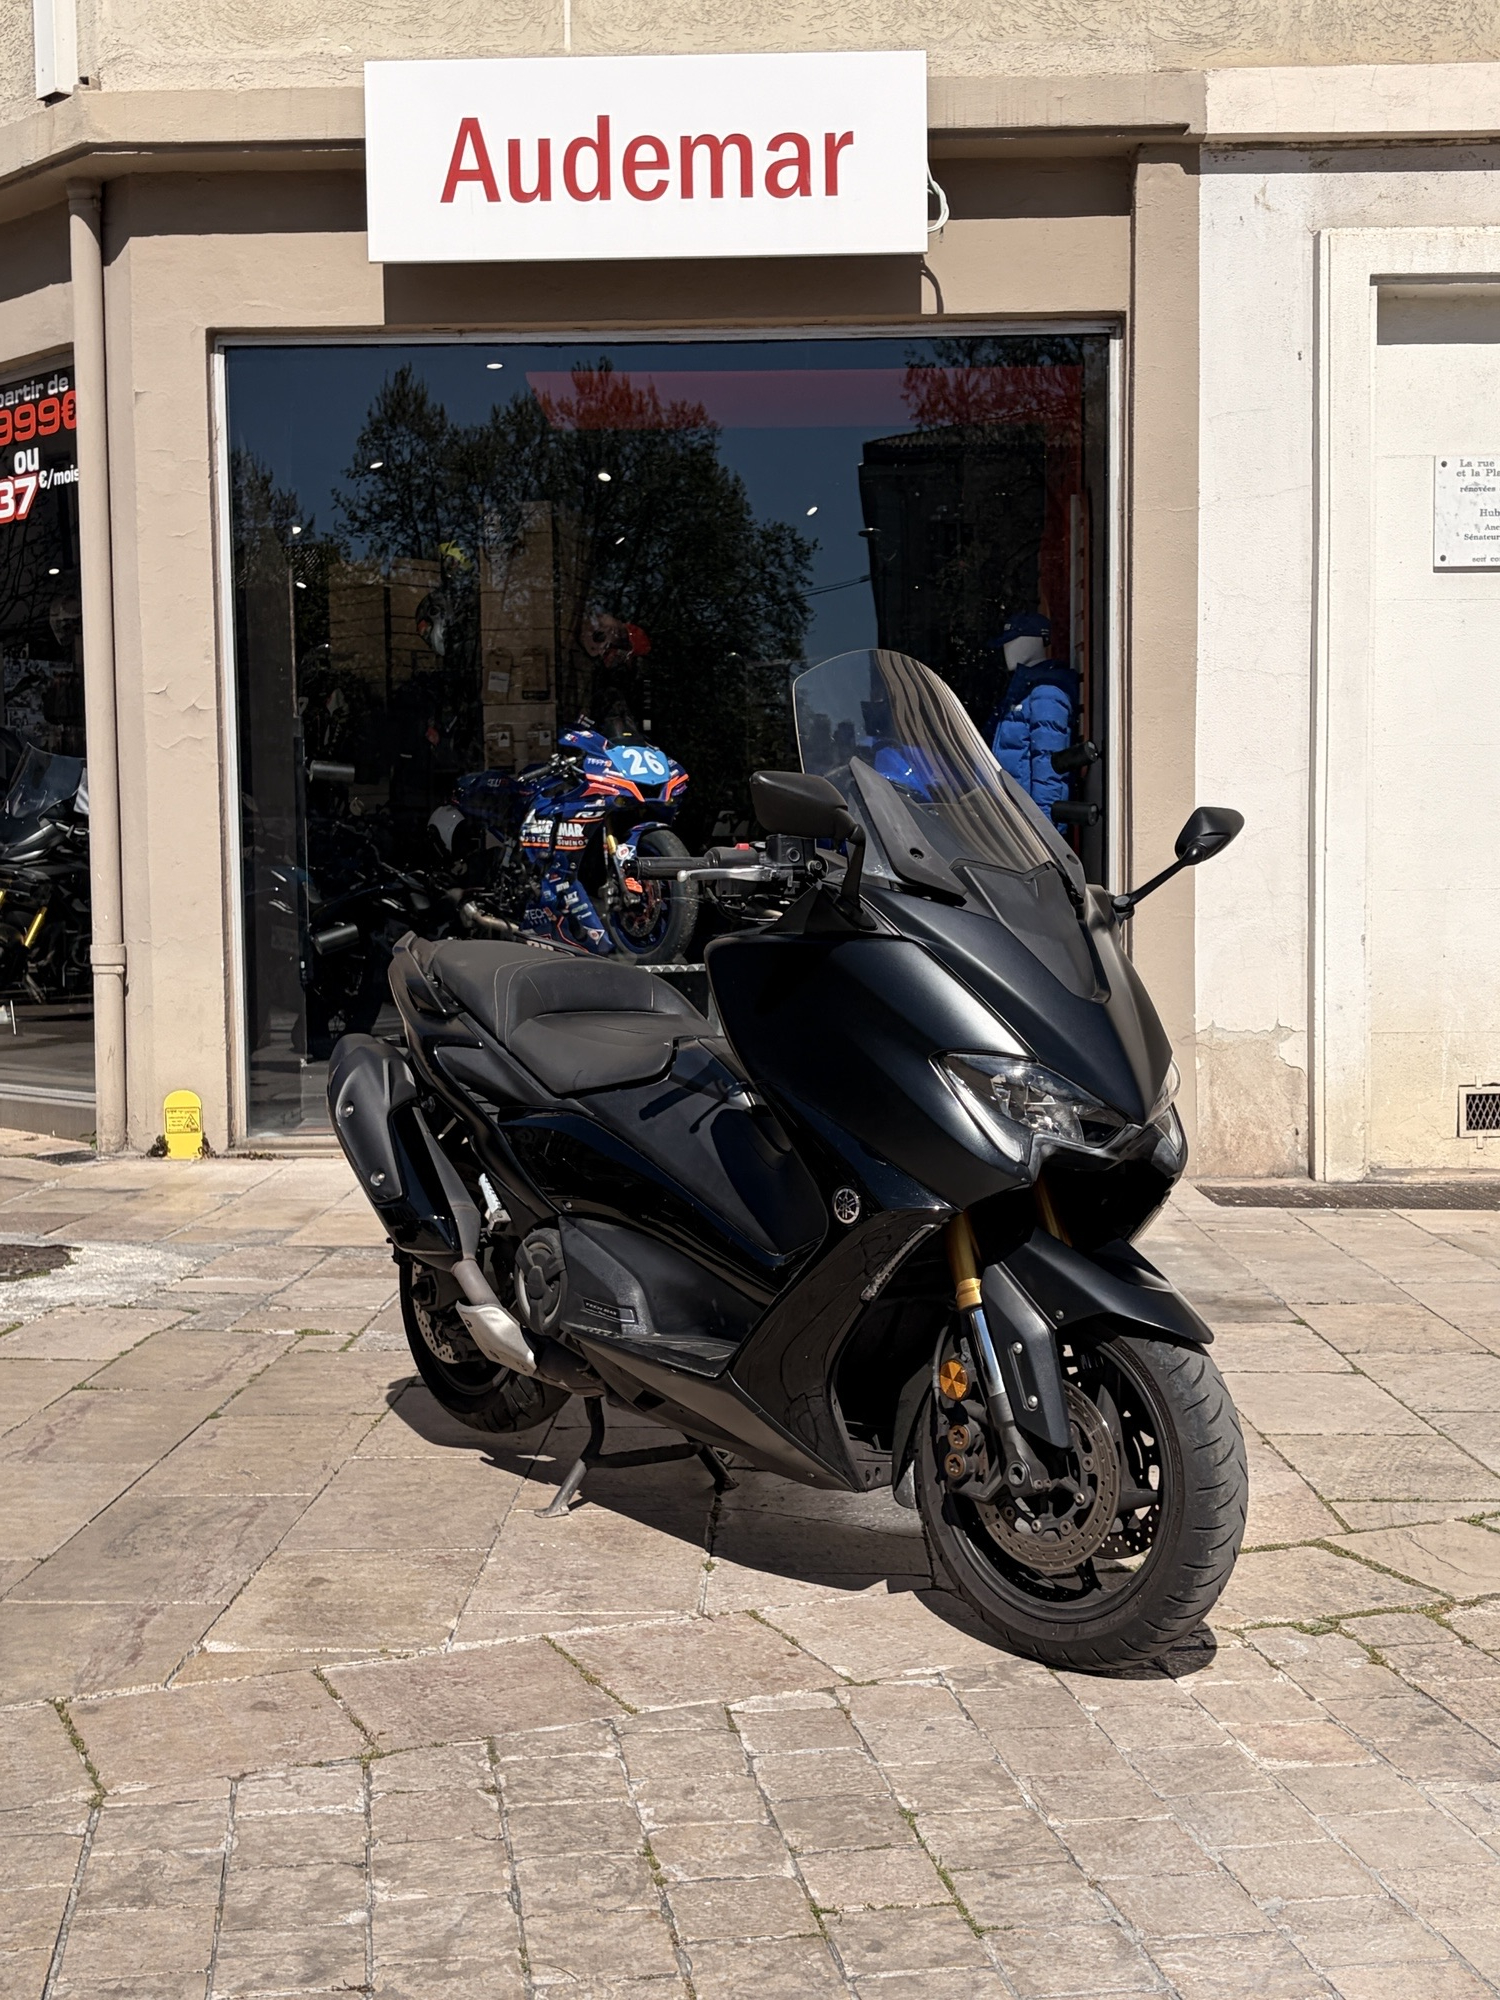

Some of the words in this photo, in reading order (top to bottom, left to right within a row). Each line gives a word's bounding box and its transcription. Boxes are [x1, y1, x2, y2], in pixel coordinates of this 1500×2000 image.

[440, 115, 854, 203] Audemar
[48, 374, 69, 395] de
[14, 447, 39, 475] ou
[1459, 459, 1472, 467] La
[1471, 469, 1480, 477] la
[622, 748, 665, 776] 26
